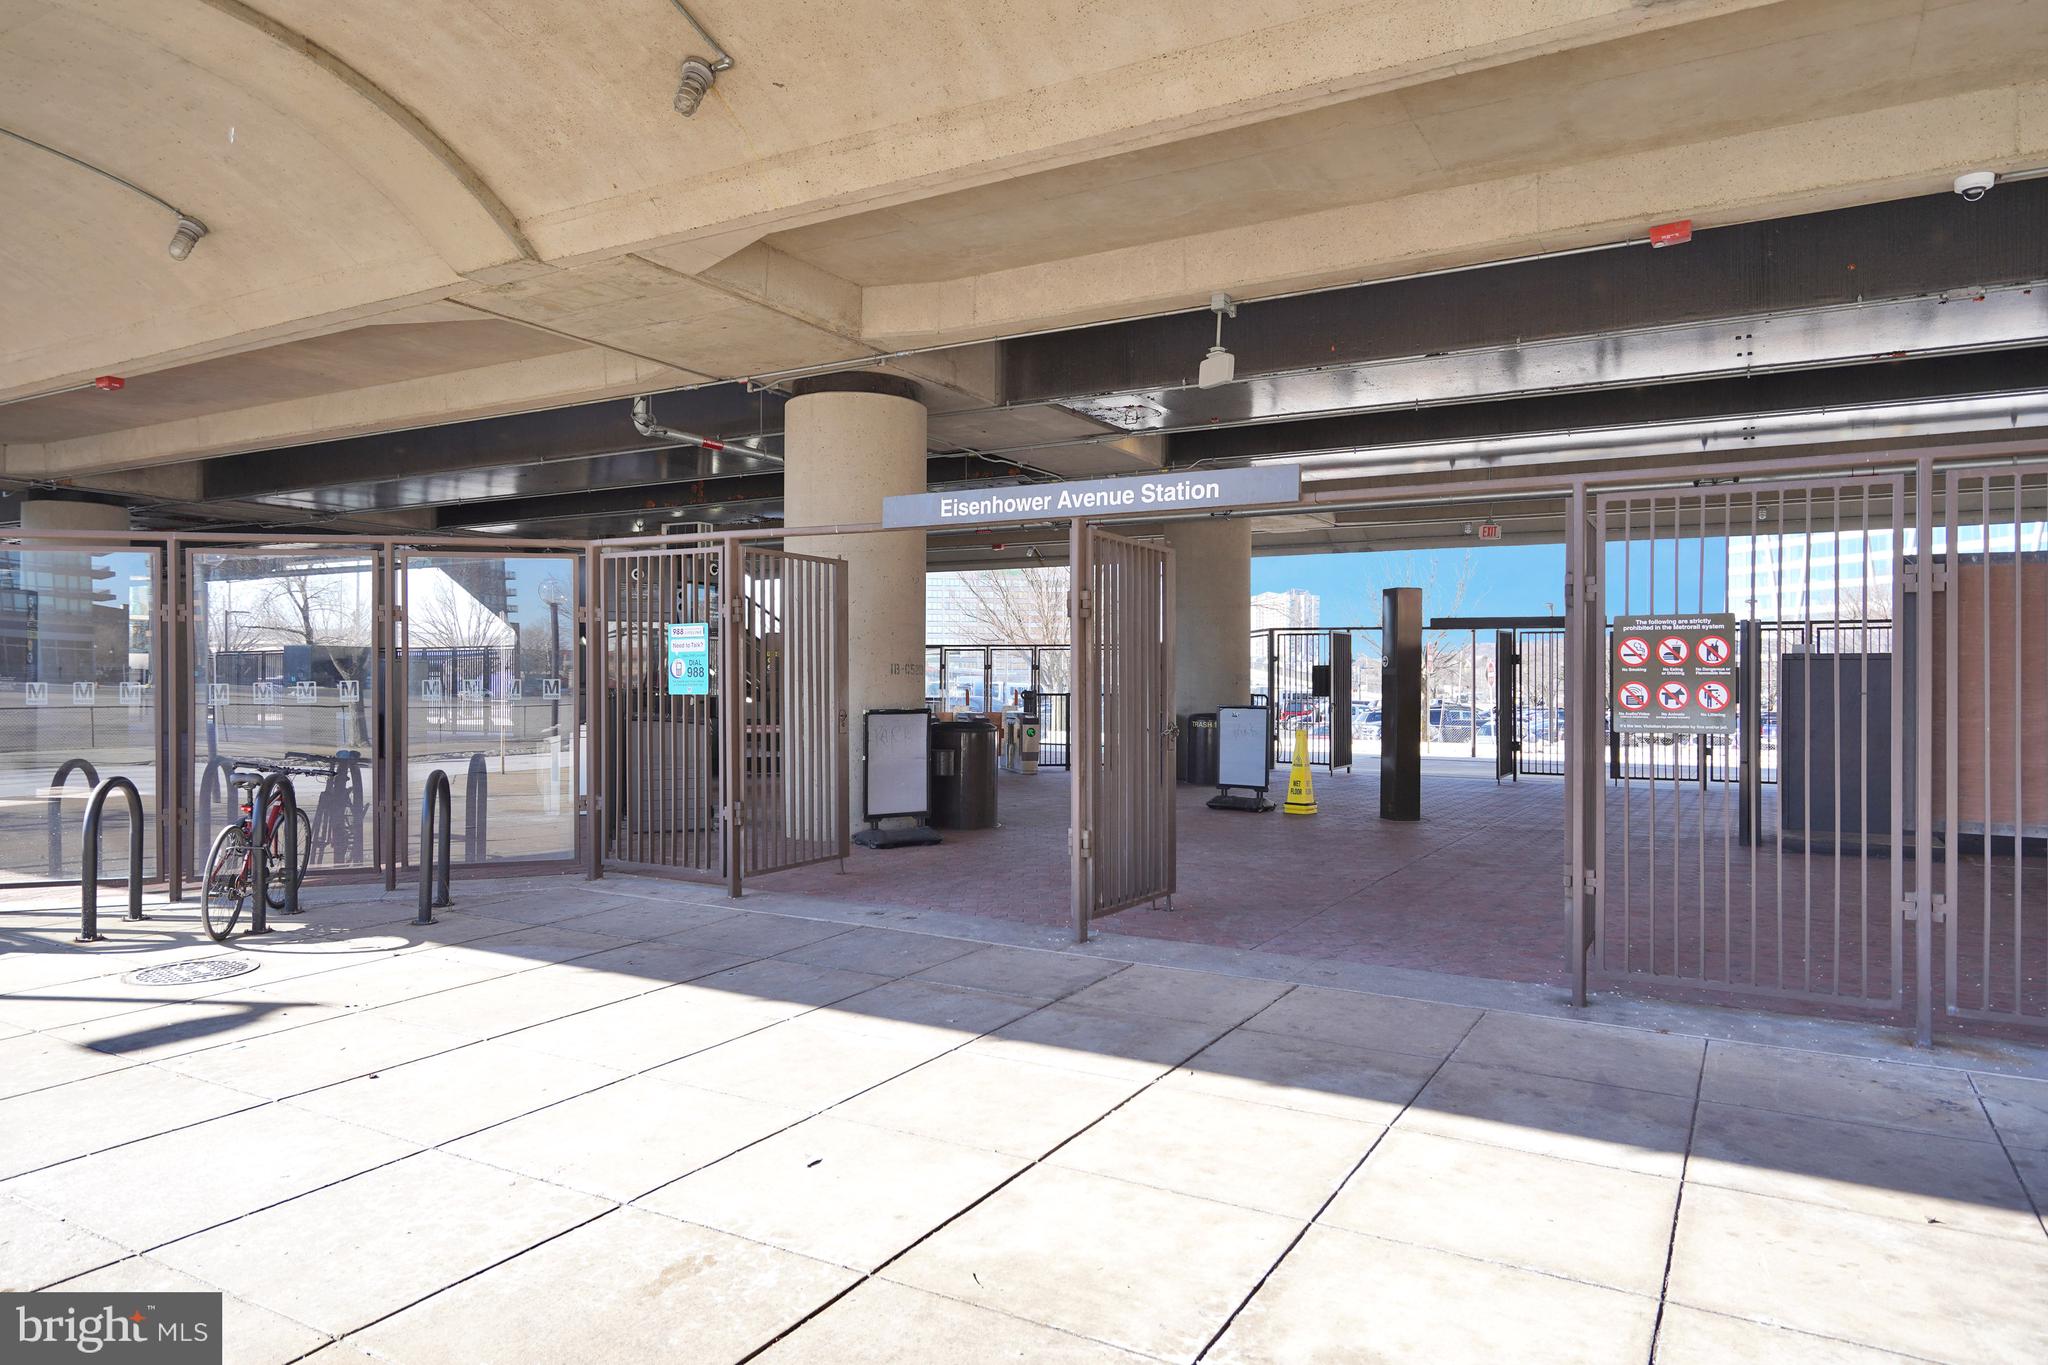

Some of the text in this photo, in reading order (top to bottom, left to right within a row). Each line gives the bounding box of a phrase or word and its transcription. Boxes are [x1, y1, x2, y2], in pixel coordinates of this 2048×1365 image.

[941, 481, 1219, 517] Eisenhower Avenue Station
[1483, 526, 1497, 537] EXIT
[1648, 619, 1677, 627] following
[687, 667, 705, 678] 988
[342, 682, 358, 697] M
[544, 680, 559, 694] M
[1192, 720, 1213, 728] TRASH
